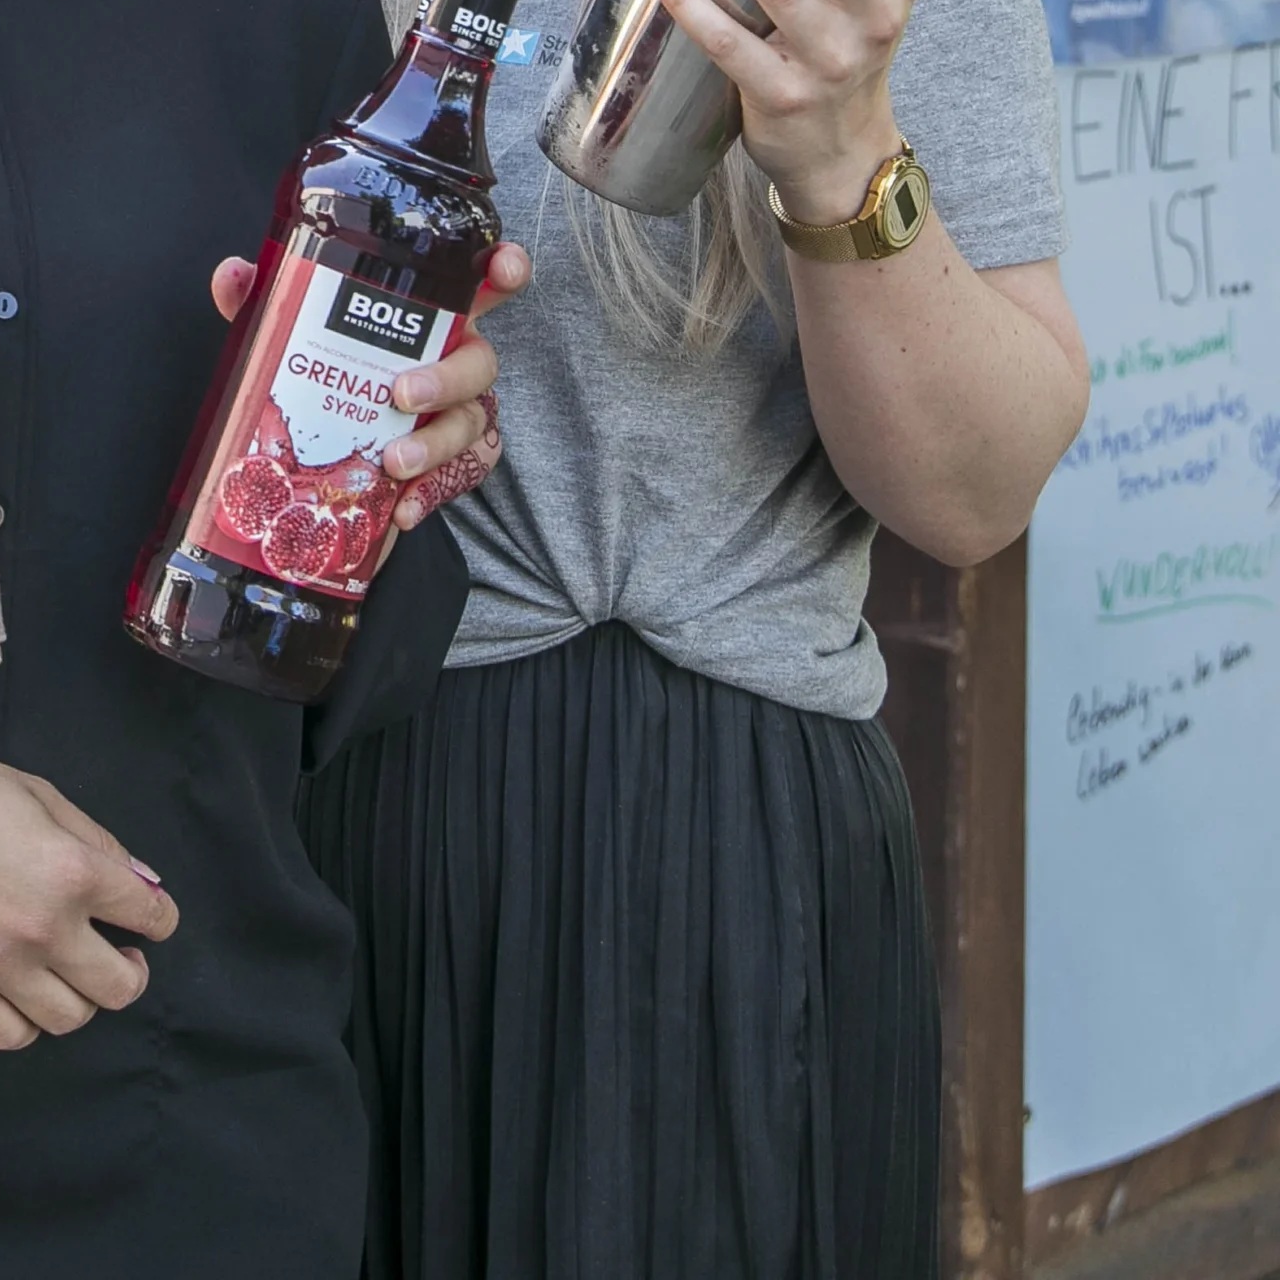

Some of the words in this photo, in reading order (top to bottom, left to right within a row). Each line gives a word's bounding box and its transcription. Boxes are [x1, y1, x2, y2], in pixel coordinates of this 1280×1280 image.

[450, 24, 482, 40] SINCE
[454, 7, 507, 38] BOLS
[1072, 54, 1200, 183] EINE
[347, 292, 424, 335] BOLS
[288, 353, 398, 410] GRENAD
[322, 394, 379, 425] SYRUP
